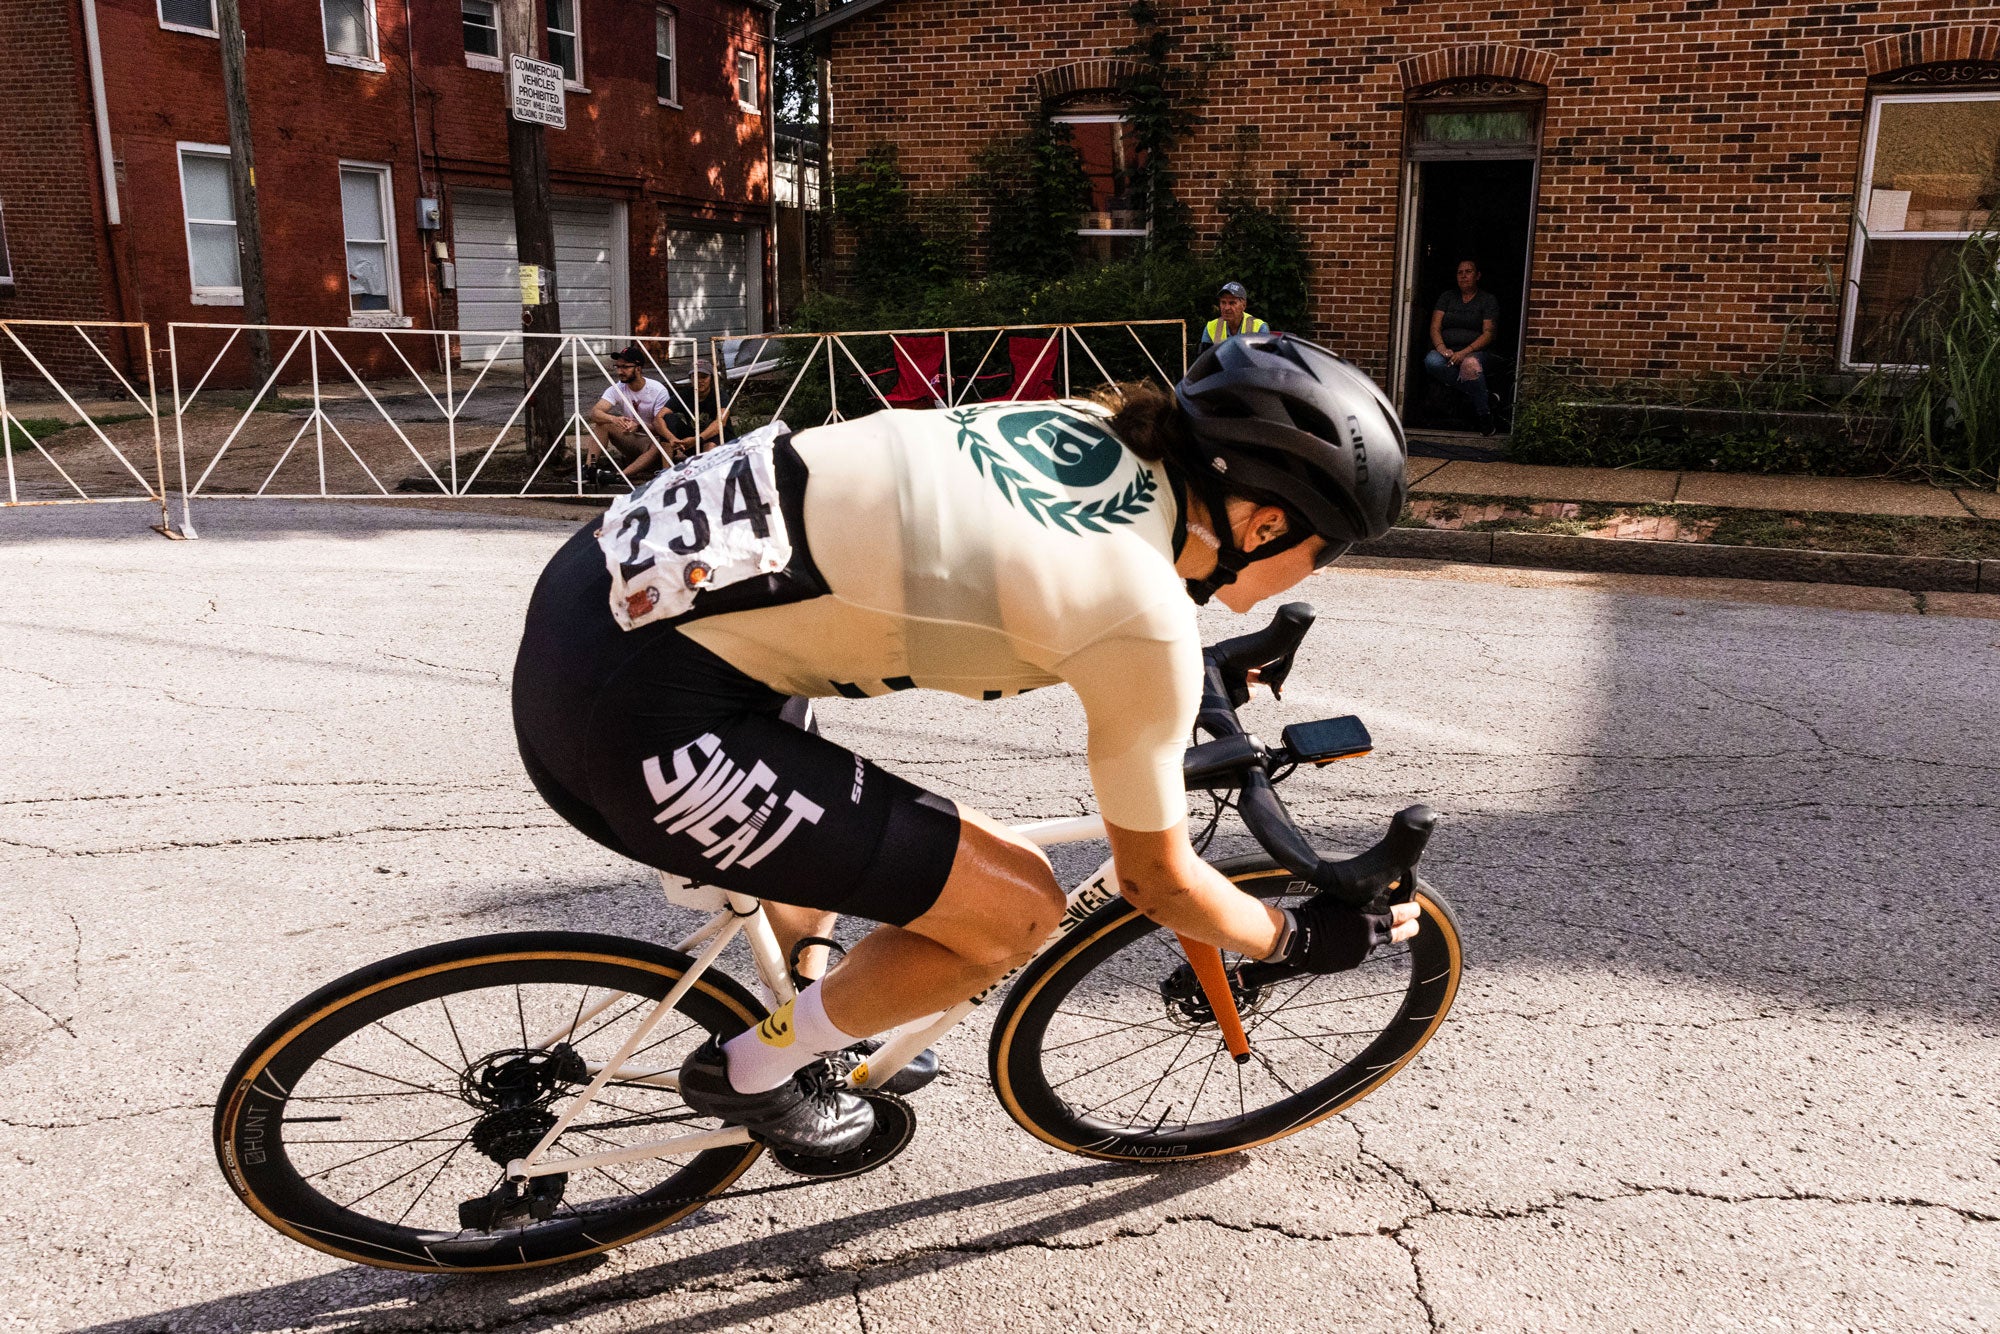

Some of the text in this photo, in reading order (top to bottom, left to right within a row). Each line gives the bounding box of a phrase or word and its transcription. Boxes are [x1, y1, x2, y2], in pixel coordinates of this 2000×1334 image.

[514, 59, 561, 80] COMMERCIAL
[522, 74, 556, 91] VEHICLES
[518, 86, 560, 104] PROHIBITED
[616, 456, 772, 582] 234
[850, 753, 865, 804] SRA
[244, 1105, 269, 1152] HUNT
[1116, 1145, 1170, 1156] HUNT
